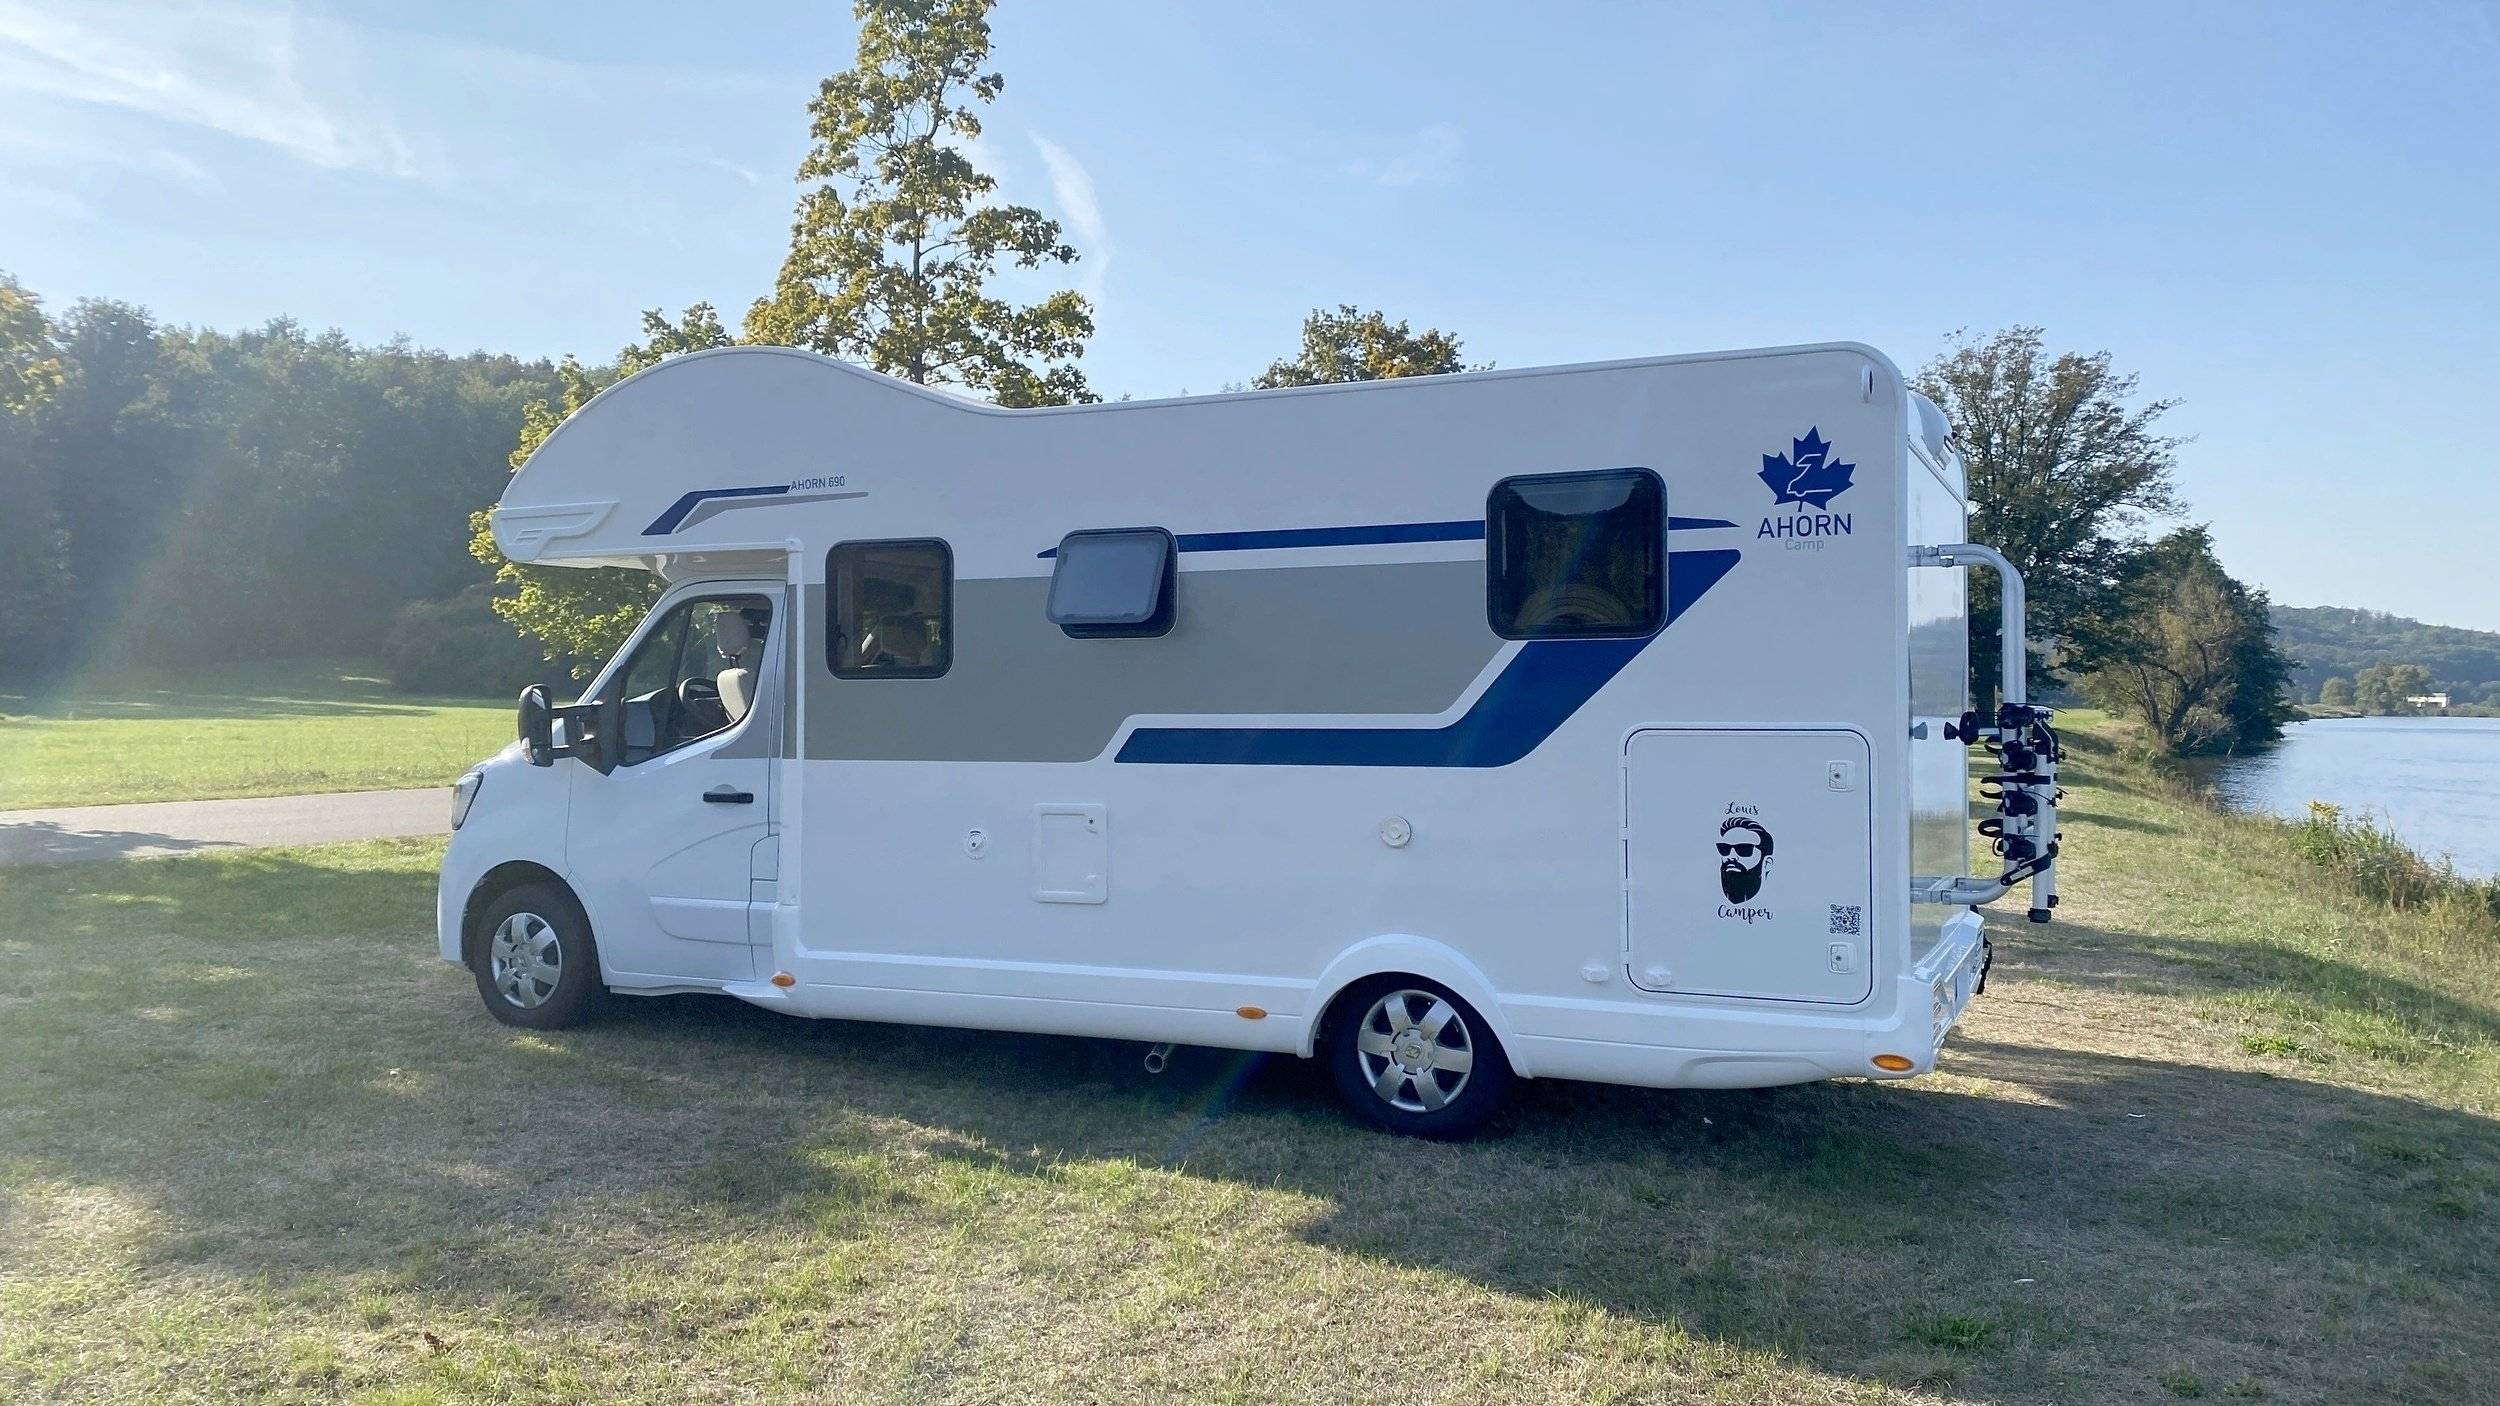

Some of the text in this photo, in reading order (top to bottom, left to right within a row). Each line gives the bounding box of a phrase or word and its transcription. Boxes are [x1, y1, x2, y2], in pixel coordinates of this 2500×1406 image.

[791, 475, 846, 490] AHORN 690
[1757, 513, 1851, 539] AHORN
[1785, 539, 1825, 552] Camp
[1725, 801, 1760, 815] Louis
[1717, 904, 1774, 925] Camper
